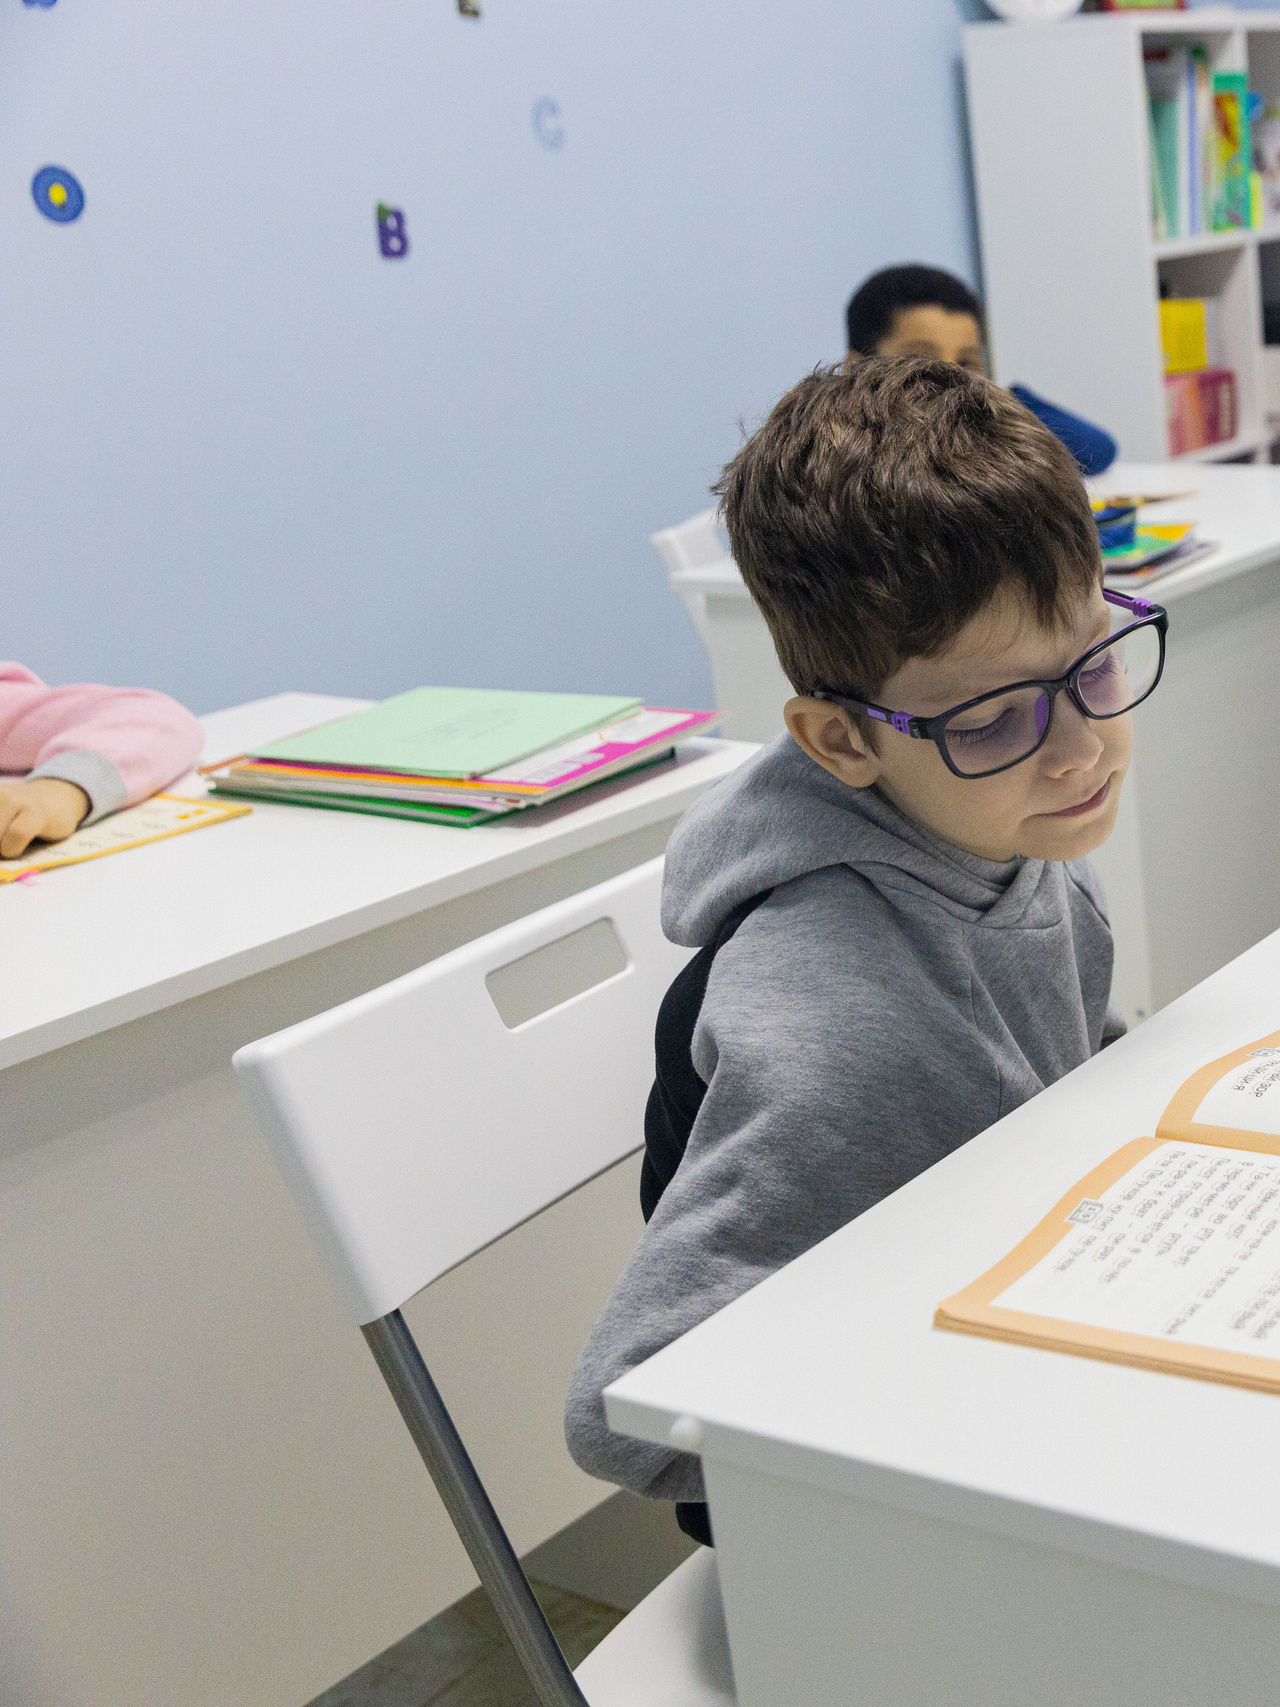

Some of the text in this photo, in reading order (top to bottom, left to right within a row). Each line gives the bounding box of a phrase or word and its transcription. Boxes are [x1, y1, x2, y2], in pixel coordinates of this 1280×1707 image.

[377, 201, 408, 260] B
[1159, 1150, 1187, 1168] Пе-тя
[1201, 1157, 1231, 1180] Пи-лот
[1122, 1169, 1164, 1201] Пе-ту-хов
[1163, 1160, 1199, 1189] пи-ра-та
[1243, 1171, 1271, 1191] Та-ни
[1189, 1168, 1244, 1219] тер-мо-мет-ре
[1225, 1194, 1247, 1211] торт
[1244, 1188, 1279, 1221] тём-ный
[1096, 1204, 1124, 1232] ку-пит
[1135, 1198, 1159, 1219] брат
[1212, 1212, 1228, 1225] во
[1195, 1227, 1215, 1242] рту
[1226, 1223, 1247, 1241] кот.
[1238, 1219, 1280, 1261] ком-на-те
